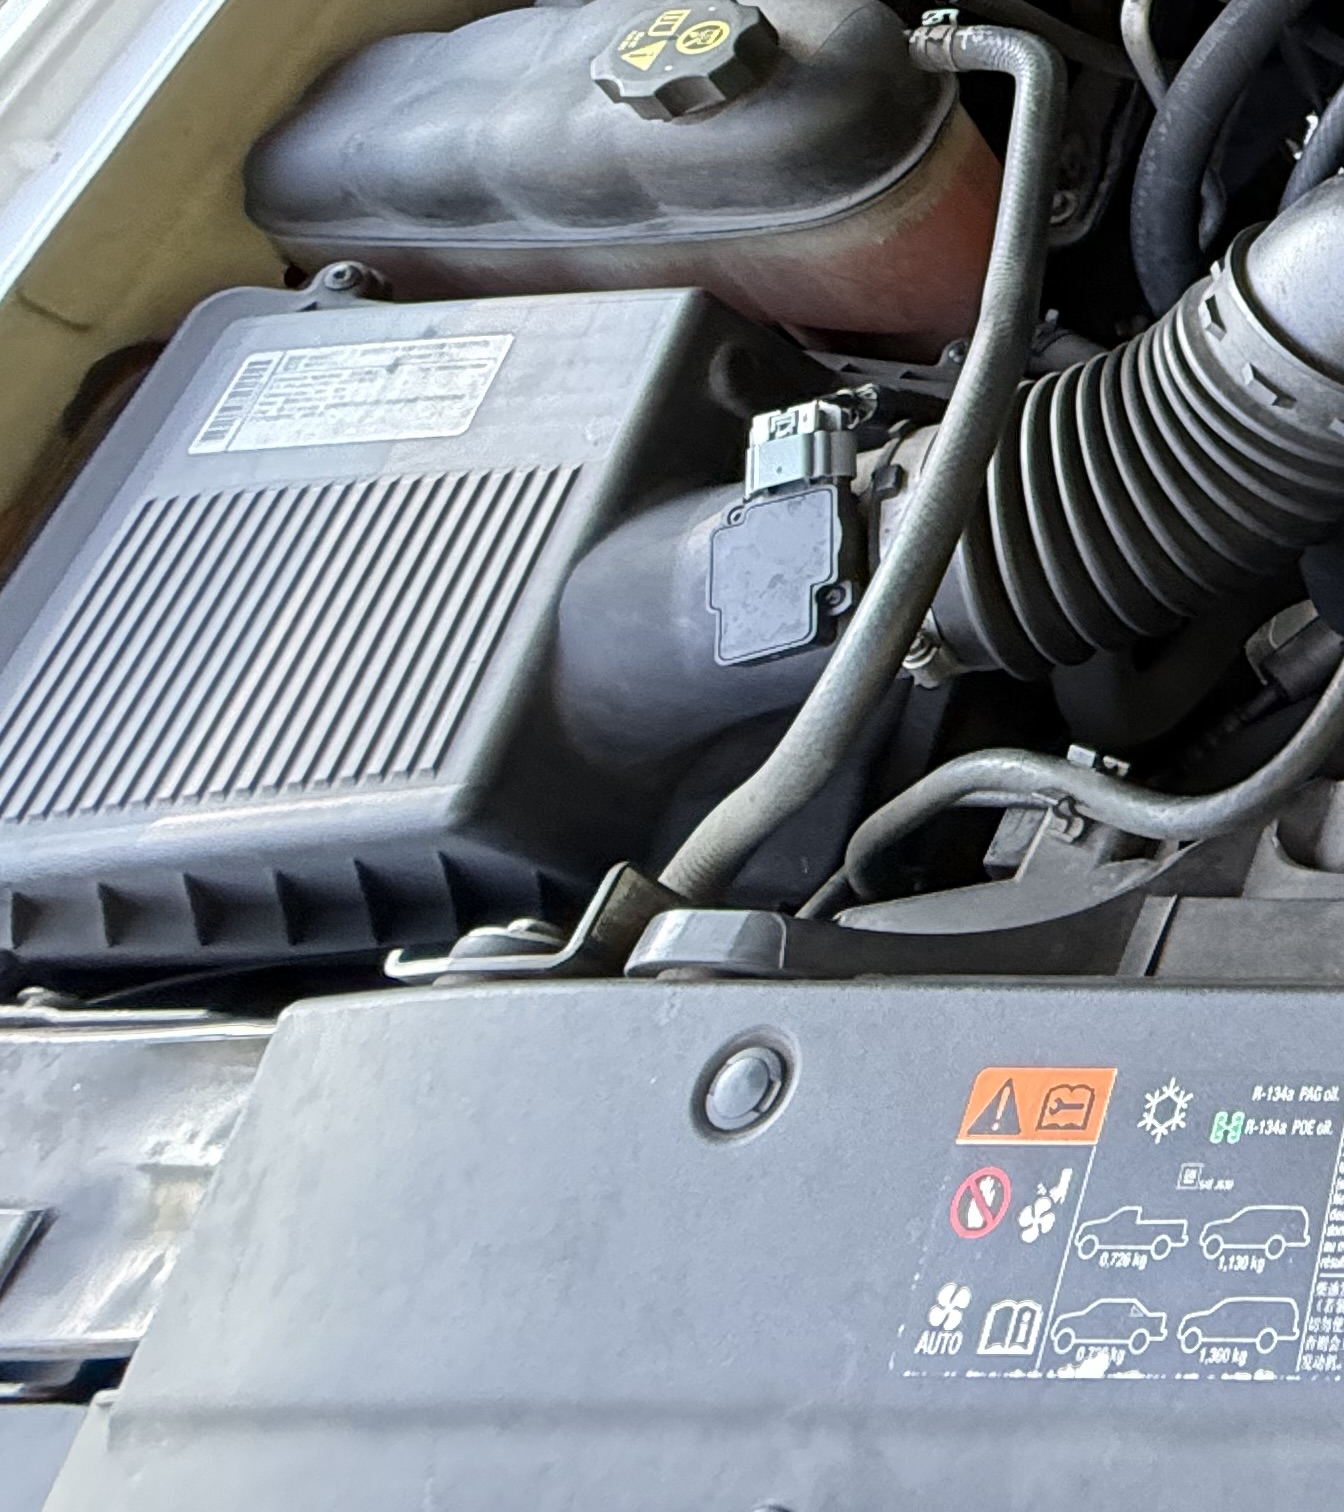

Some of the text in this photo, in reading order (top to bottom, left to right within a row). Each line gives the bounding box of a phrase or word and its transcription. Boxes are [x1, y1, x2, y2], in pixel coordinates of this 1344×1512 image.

[1252, 1085, 1296, 1101] R-134a
[1244, 1118, 1288, 1135] R-134a
[1131, 1251, 1148, 1271] kg
[1250, 1255, 1266, 1274] kg
[914, 1331, 963, 1355] AUTO
[1231, 1348, 1248, 1367] kg
